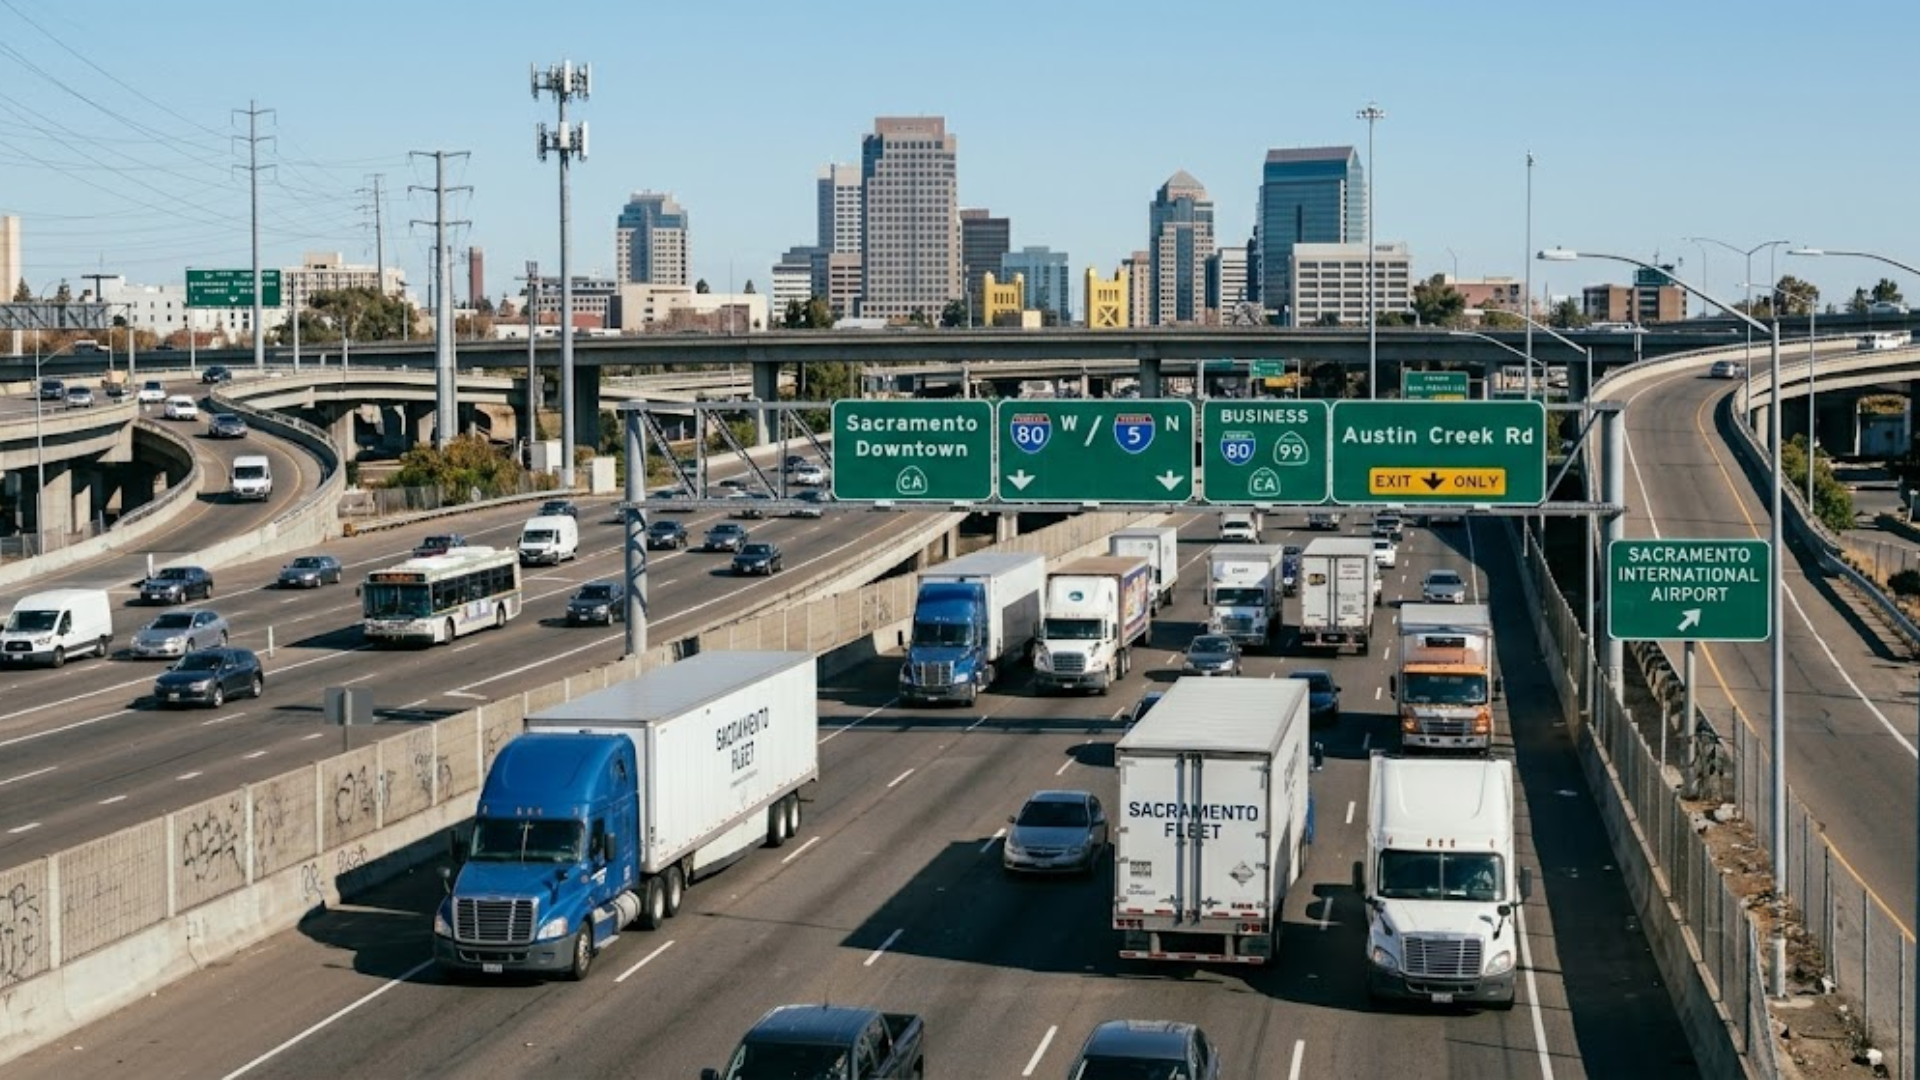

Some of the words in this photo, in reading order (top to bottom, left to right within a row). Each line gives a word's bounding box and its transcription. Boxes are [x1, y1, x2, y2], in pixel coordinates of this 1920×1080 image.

[846, 414, 978, 432] Sacramento
[1220, 409, 1309, 424] BUSINESS
[1016, 426, 1045, 445] 80
[1060, 415, 1078, 431] W
[1084, 415, 1103, 447] /
[1127, 426, 1141, 444] 5
[1165, 415, 1180, 432] N
[1342, 426, 1418, 445] Austin
[1428, 426, 1494, 445] Creek
[1505, 426, 1535, 445] Rd
[855, 440, 969, 457] Downtown
[1227, 443, 1250, 459] 80
[1279, 444, 1304, 461] 99
[901, 474, 923, 490] CA
[1375, 474, 1412, 488] EXIT
[1453, 474, 1500, 489] ONLY
[1628, 547, 1751, 563] SACRAMENTO
[1618, 567, 1760, 583] INTERNATIONAL
[1650, 586, 1730, 602] AIRPORT
[1129, 801, 1259, 822] SACRAMENTO
[1164, 822, 1222, 840] FLEET
